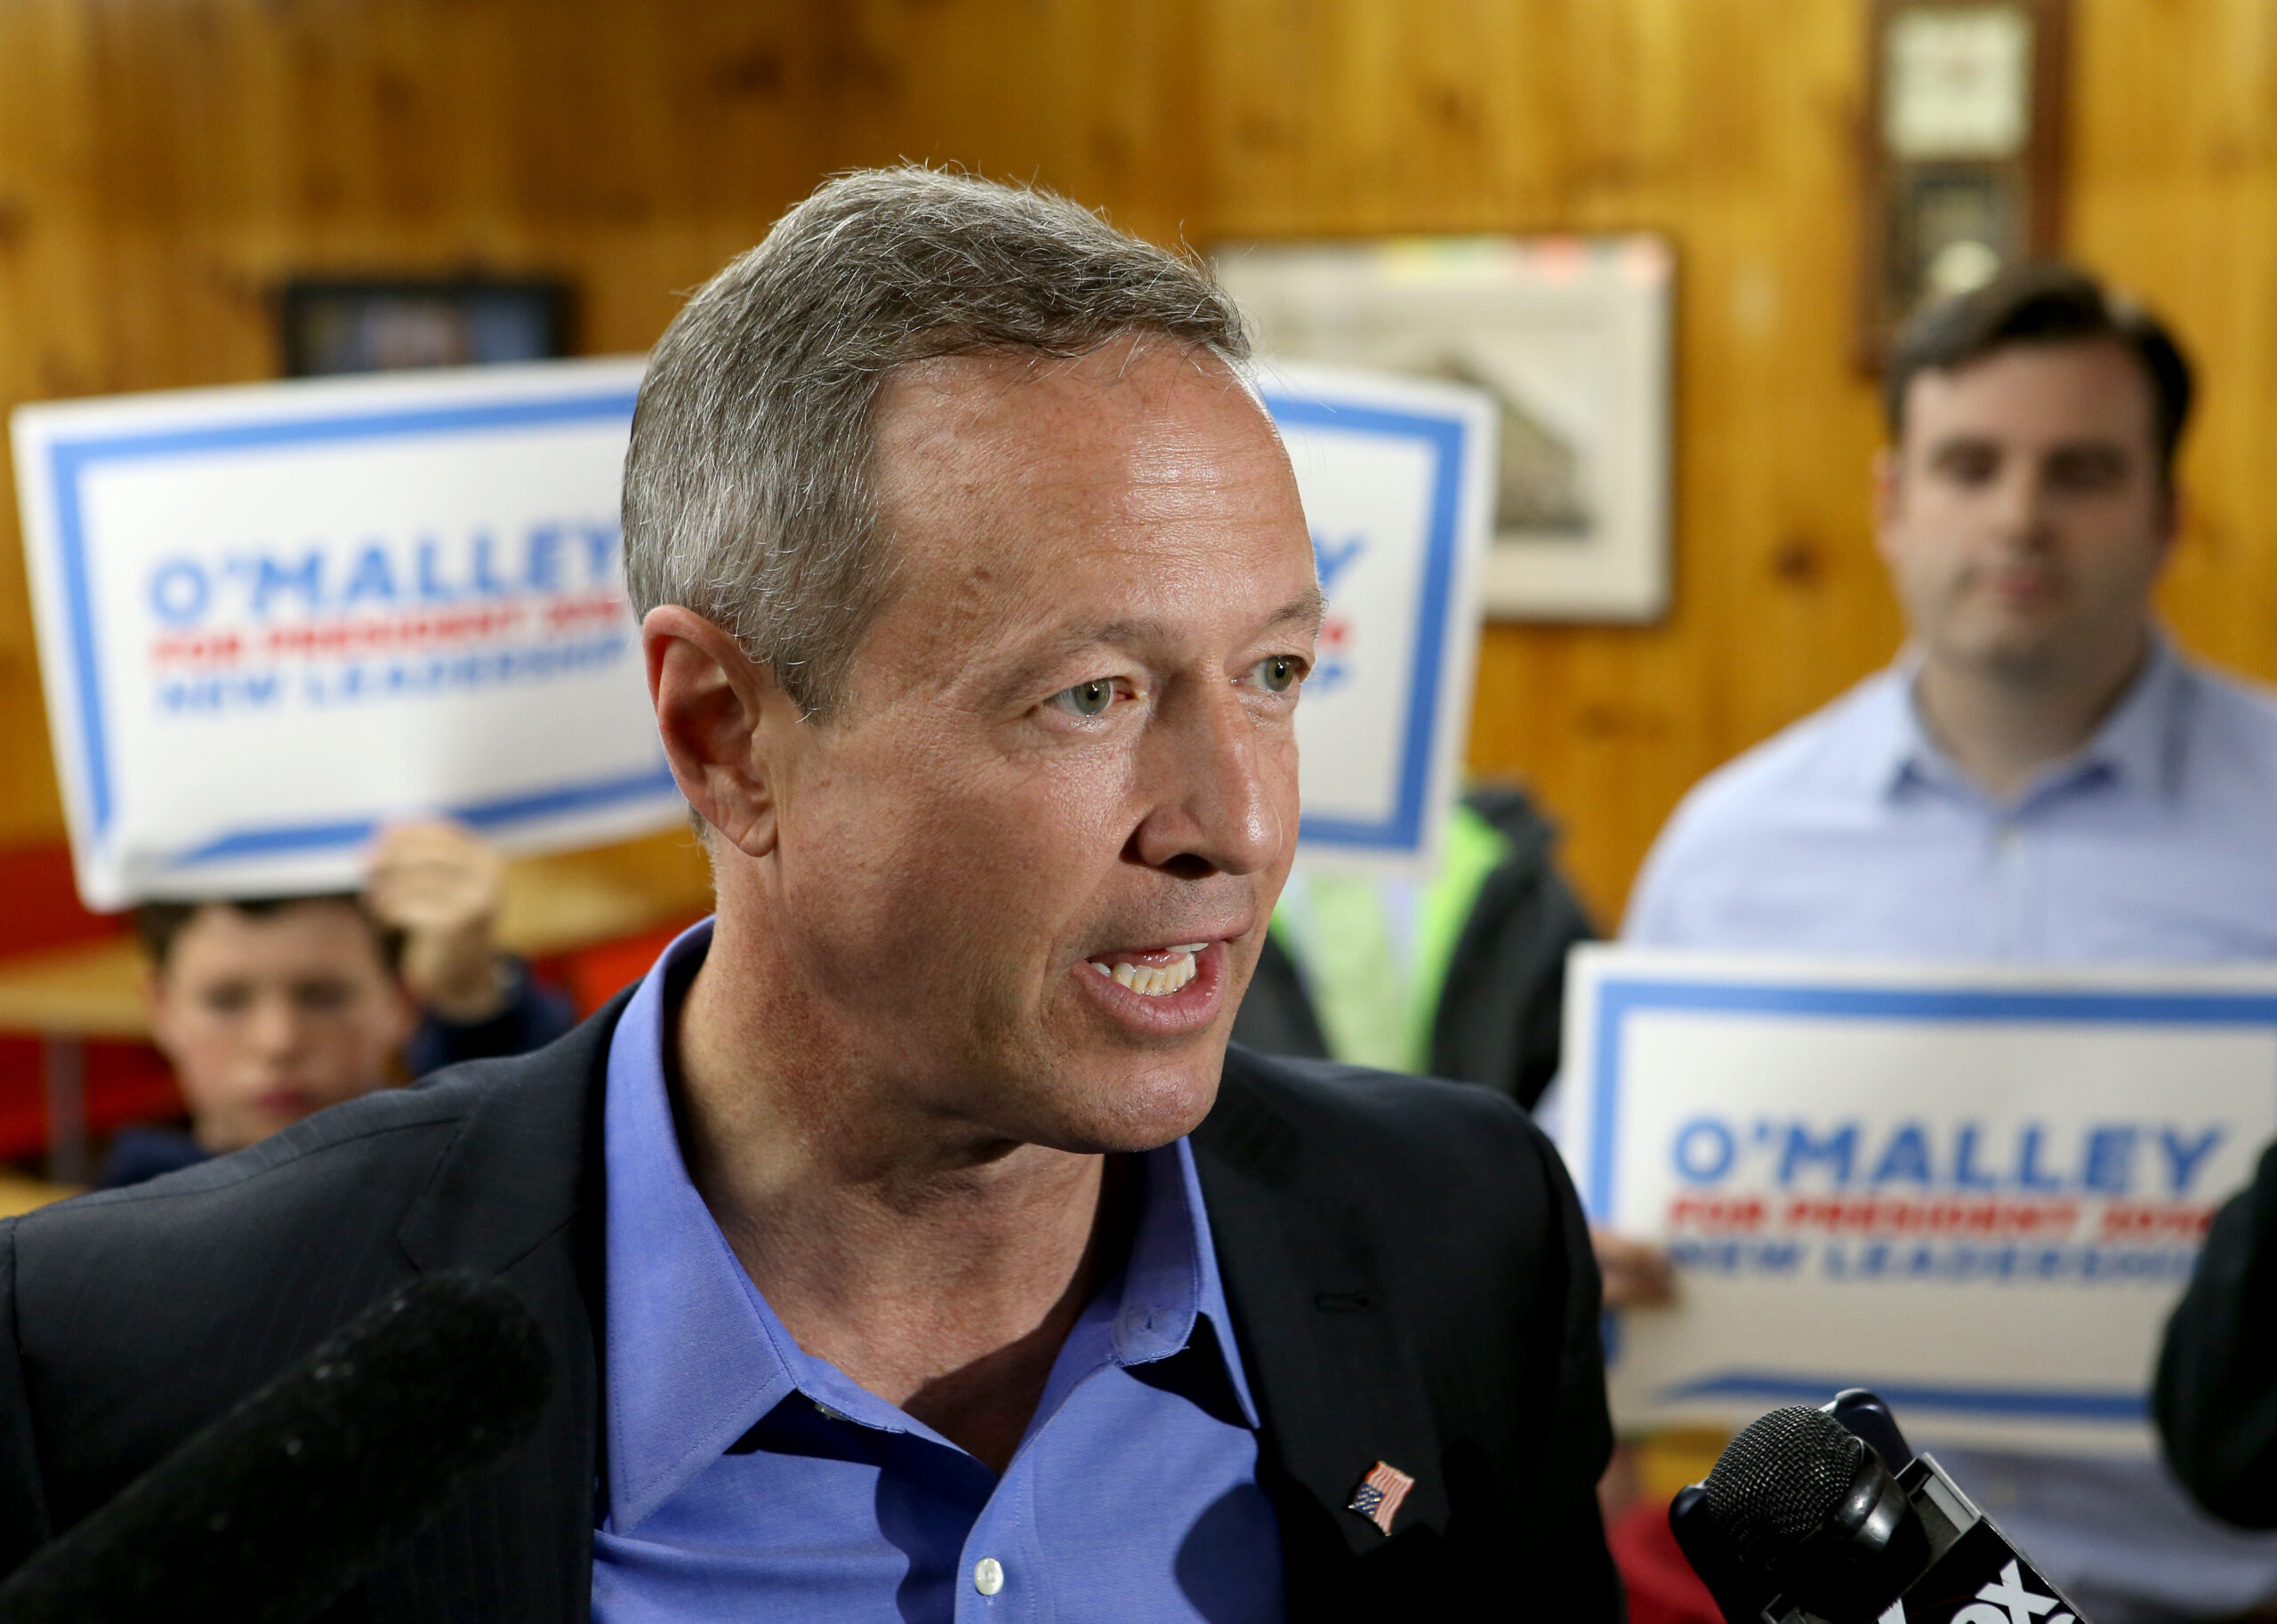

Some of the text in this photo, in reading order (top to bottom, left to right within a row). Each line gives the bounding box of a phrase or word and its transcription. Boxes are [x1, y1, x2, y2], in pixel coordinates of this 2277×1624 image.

[148, 521, 623, 624] O'MALLEY
[1670, 1115, 2224, 1194] O'MALLEY
[1668, 1196, 1766, 1235] FOR
[1782, 1197, 2081, 1240] PRESIDENT
[1667, 1241, 2203, 1280] NEW LEADERSHI
